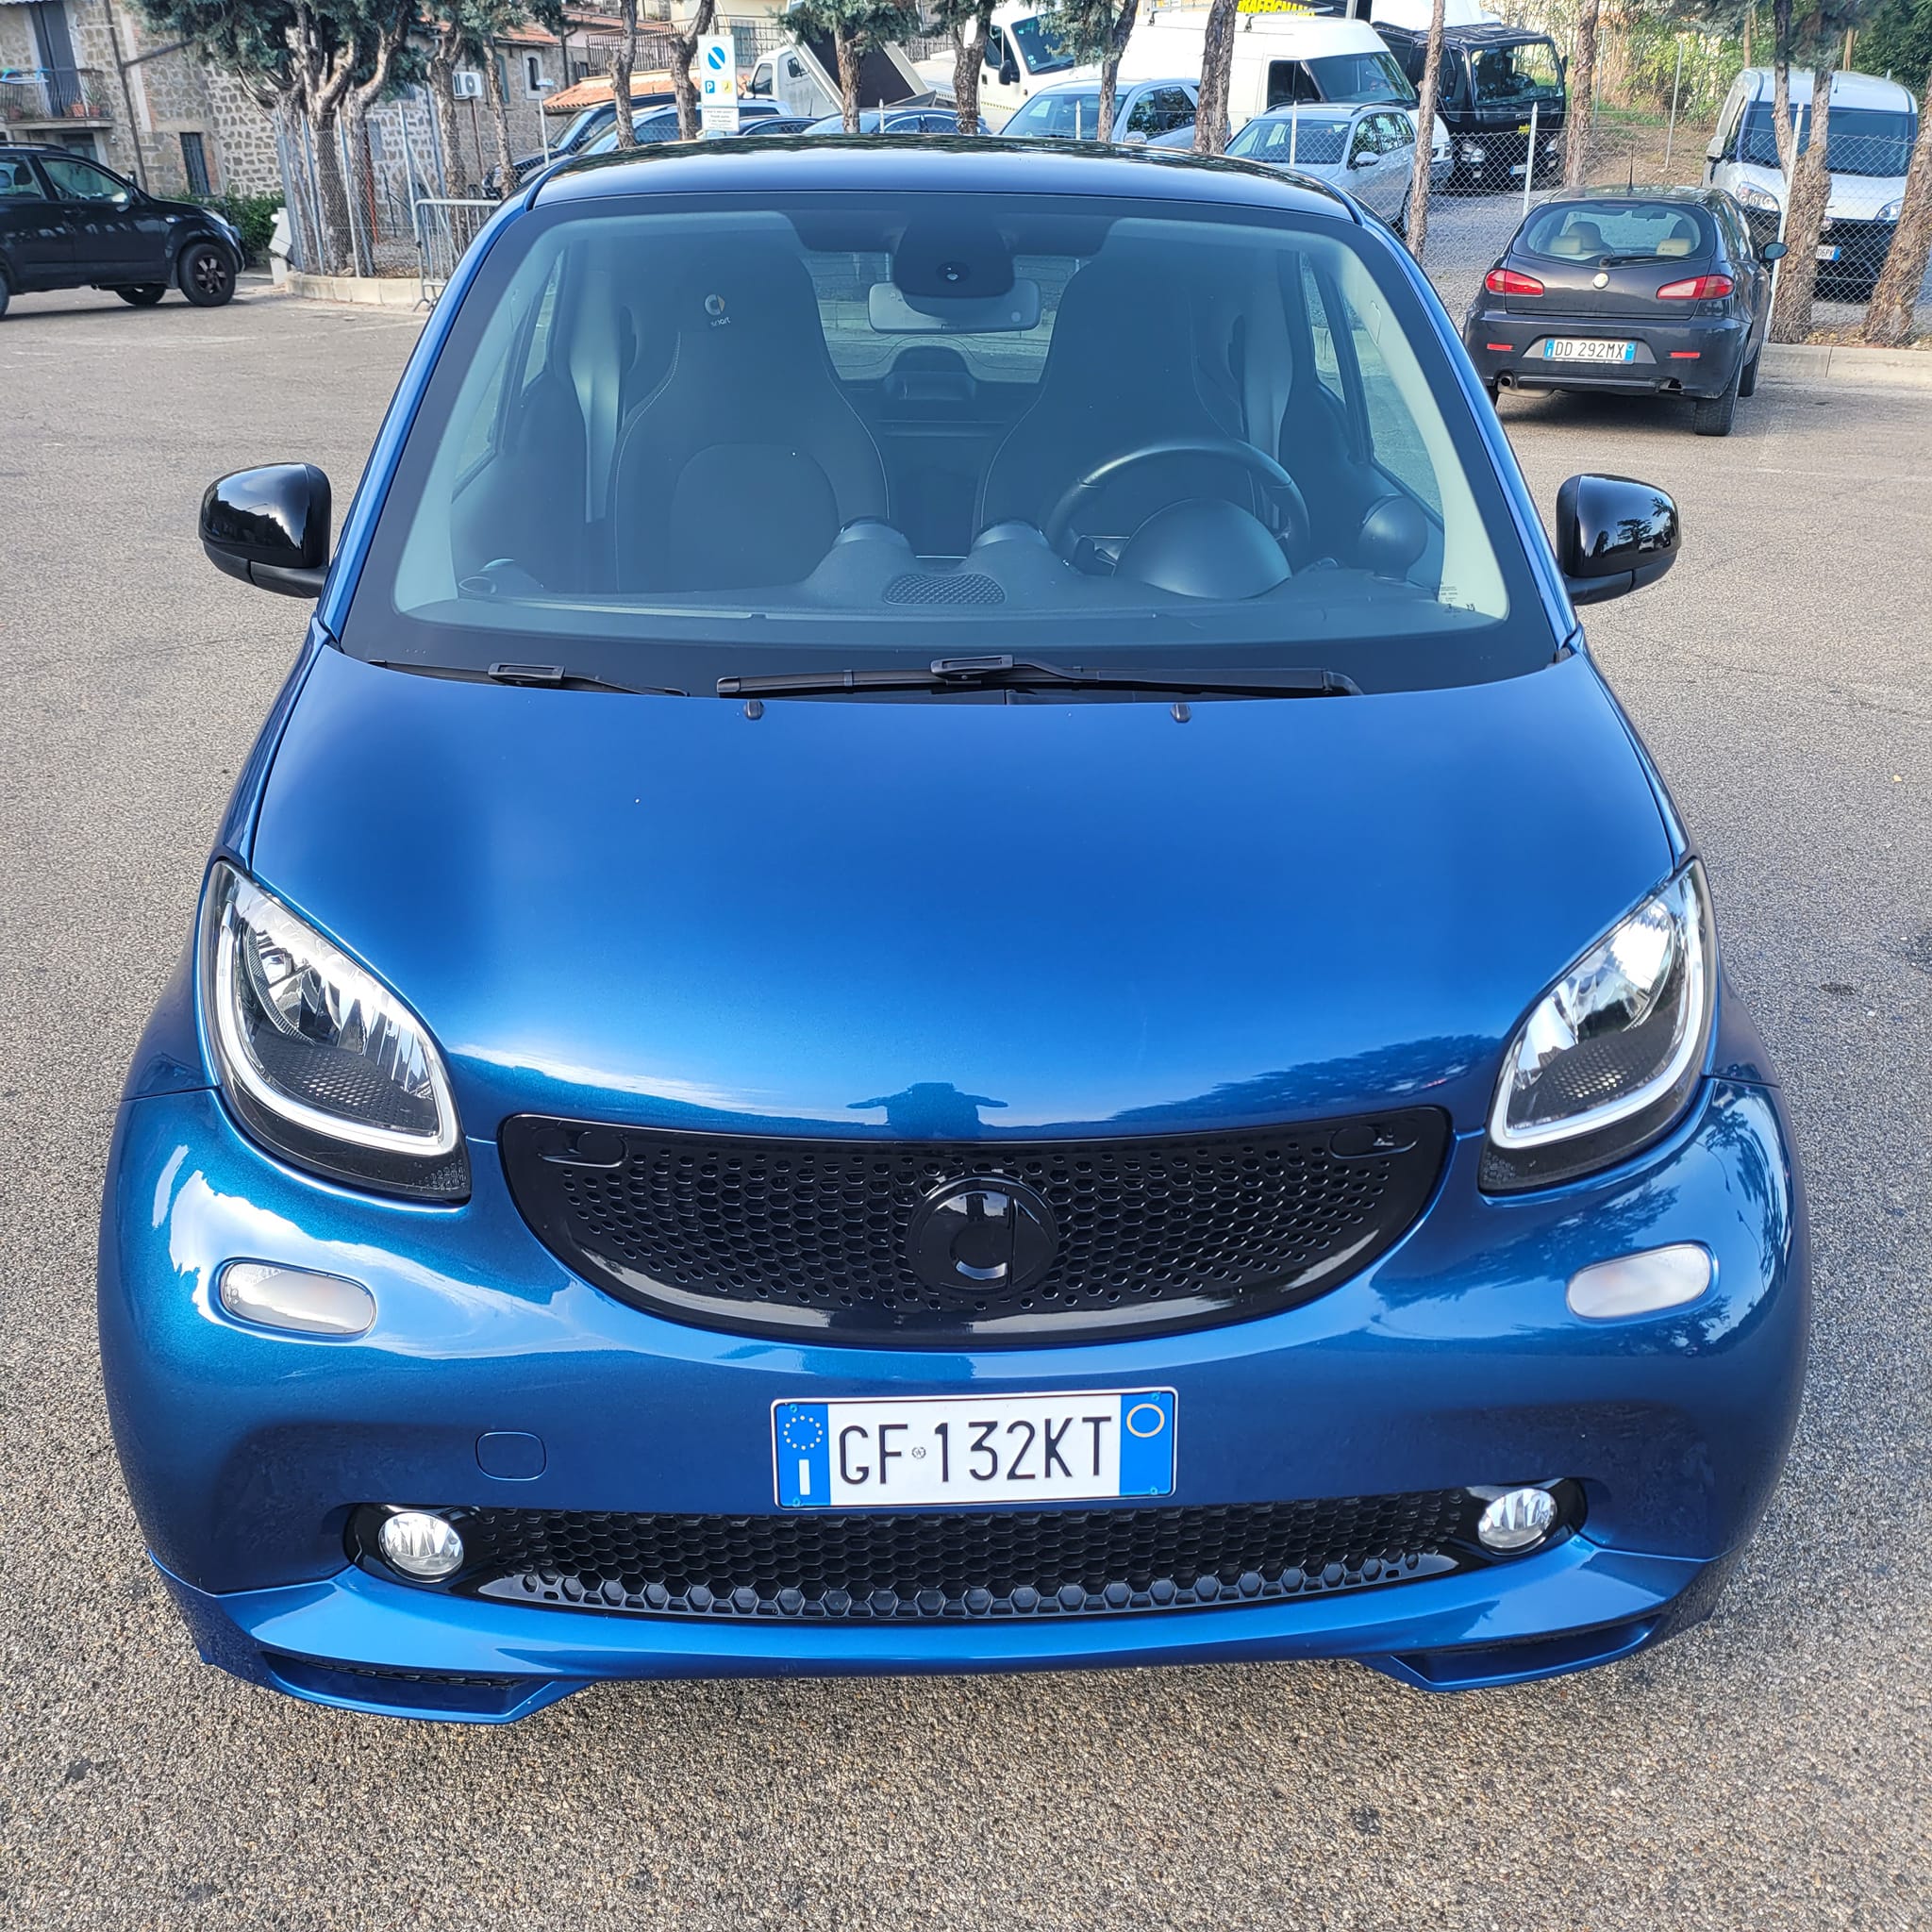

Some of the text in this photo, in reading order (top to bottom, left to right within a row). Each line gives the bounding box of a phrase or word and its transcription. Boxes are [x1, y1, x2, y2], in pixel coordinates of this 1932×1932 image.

[1555, 341, 1574, 357] DD
[1577, 341, 1624, 358] 292MX
[839, 1423, 908, 1486] GF
[934, 1415, 1112, 1483] 132KT
